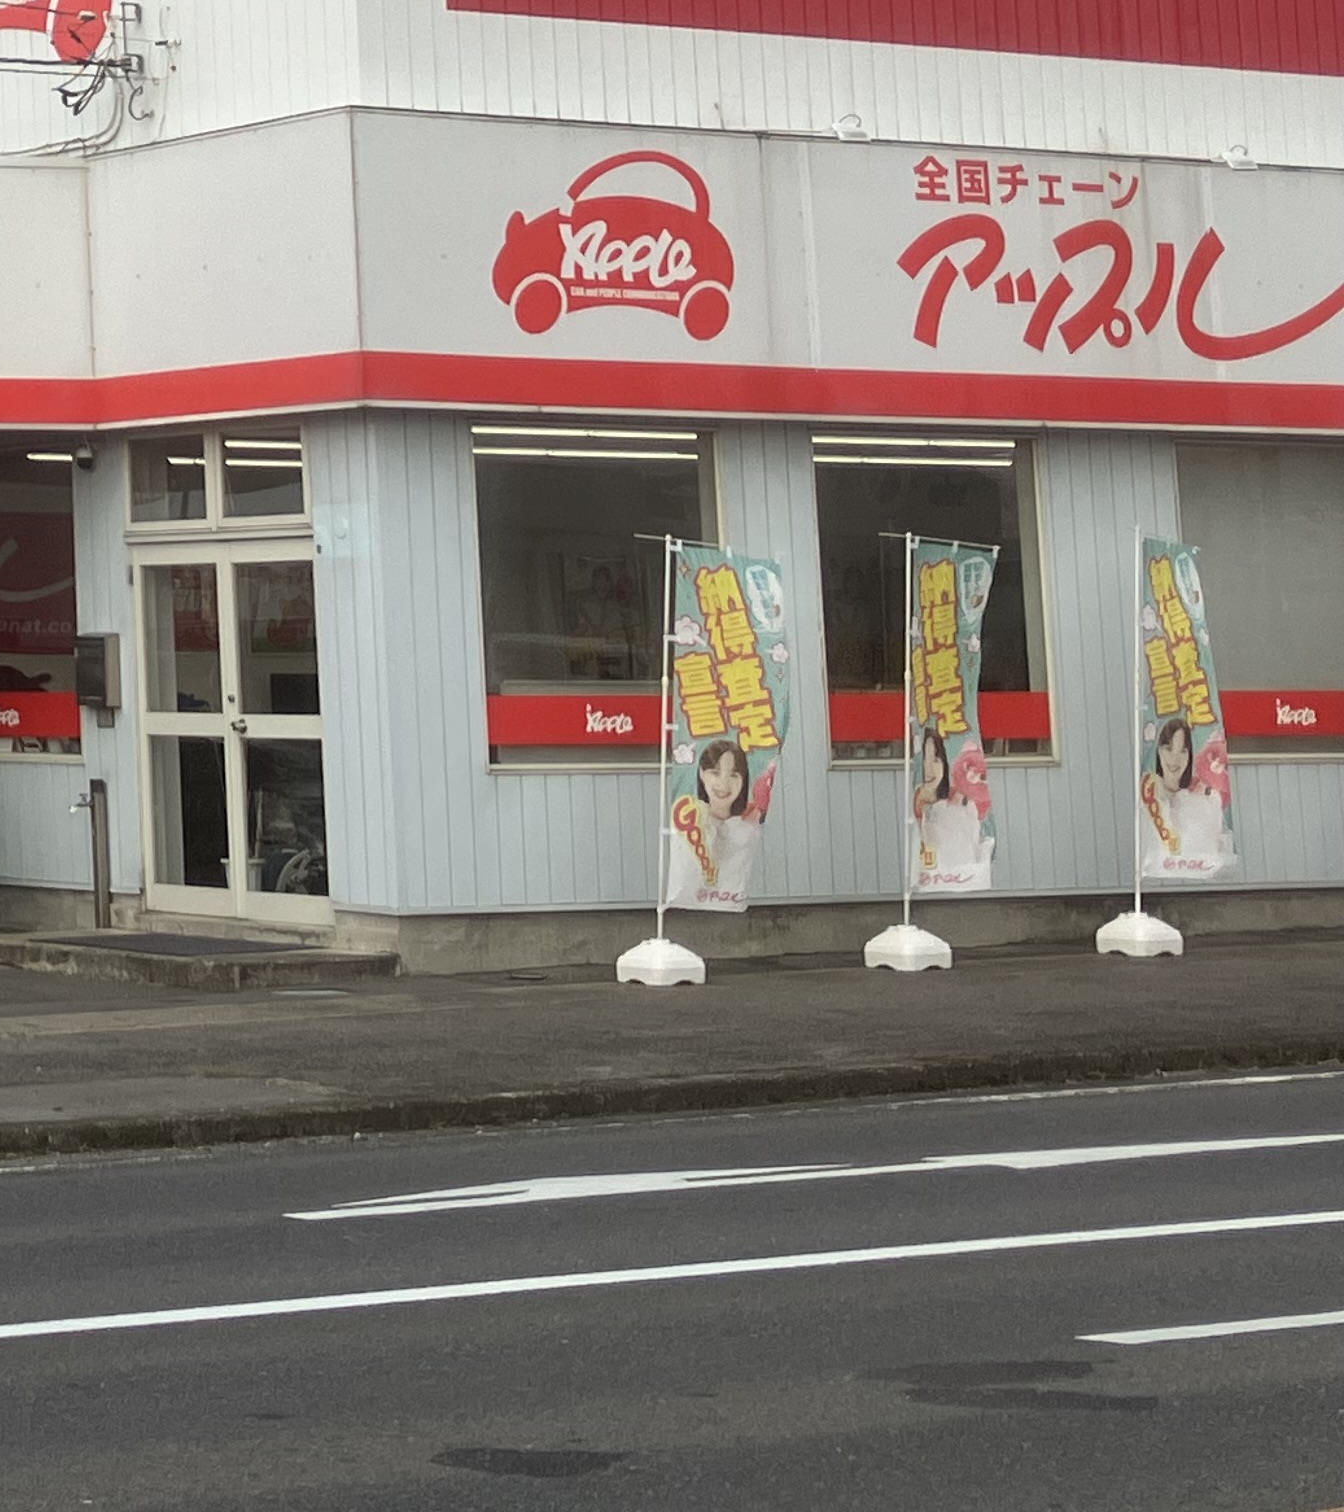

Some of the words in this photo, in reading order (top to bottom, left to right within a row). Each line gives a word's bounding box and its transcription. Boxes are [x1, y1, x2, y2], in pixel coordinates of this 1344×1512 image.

[913, 155, 1140, 210] 全国チェーン
[558, 220, 698, 288] Apple
[896, 213, 1344, 362] アップル
